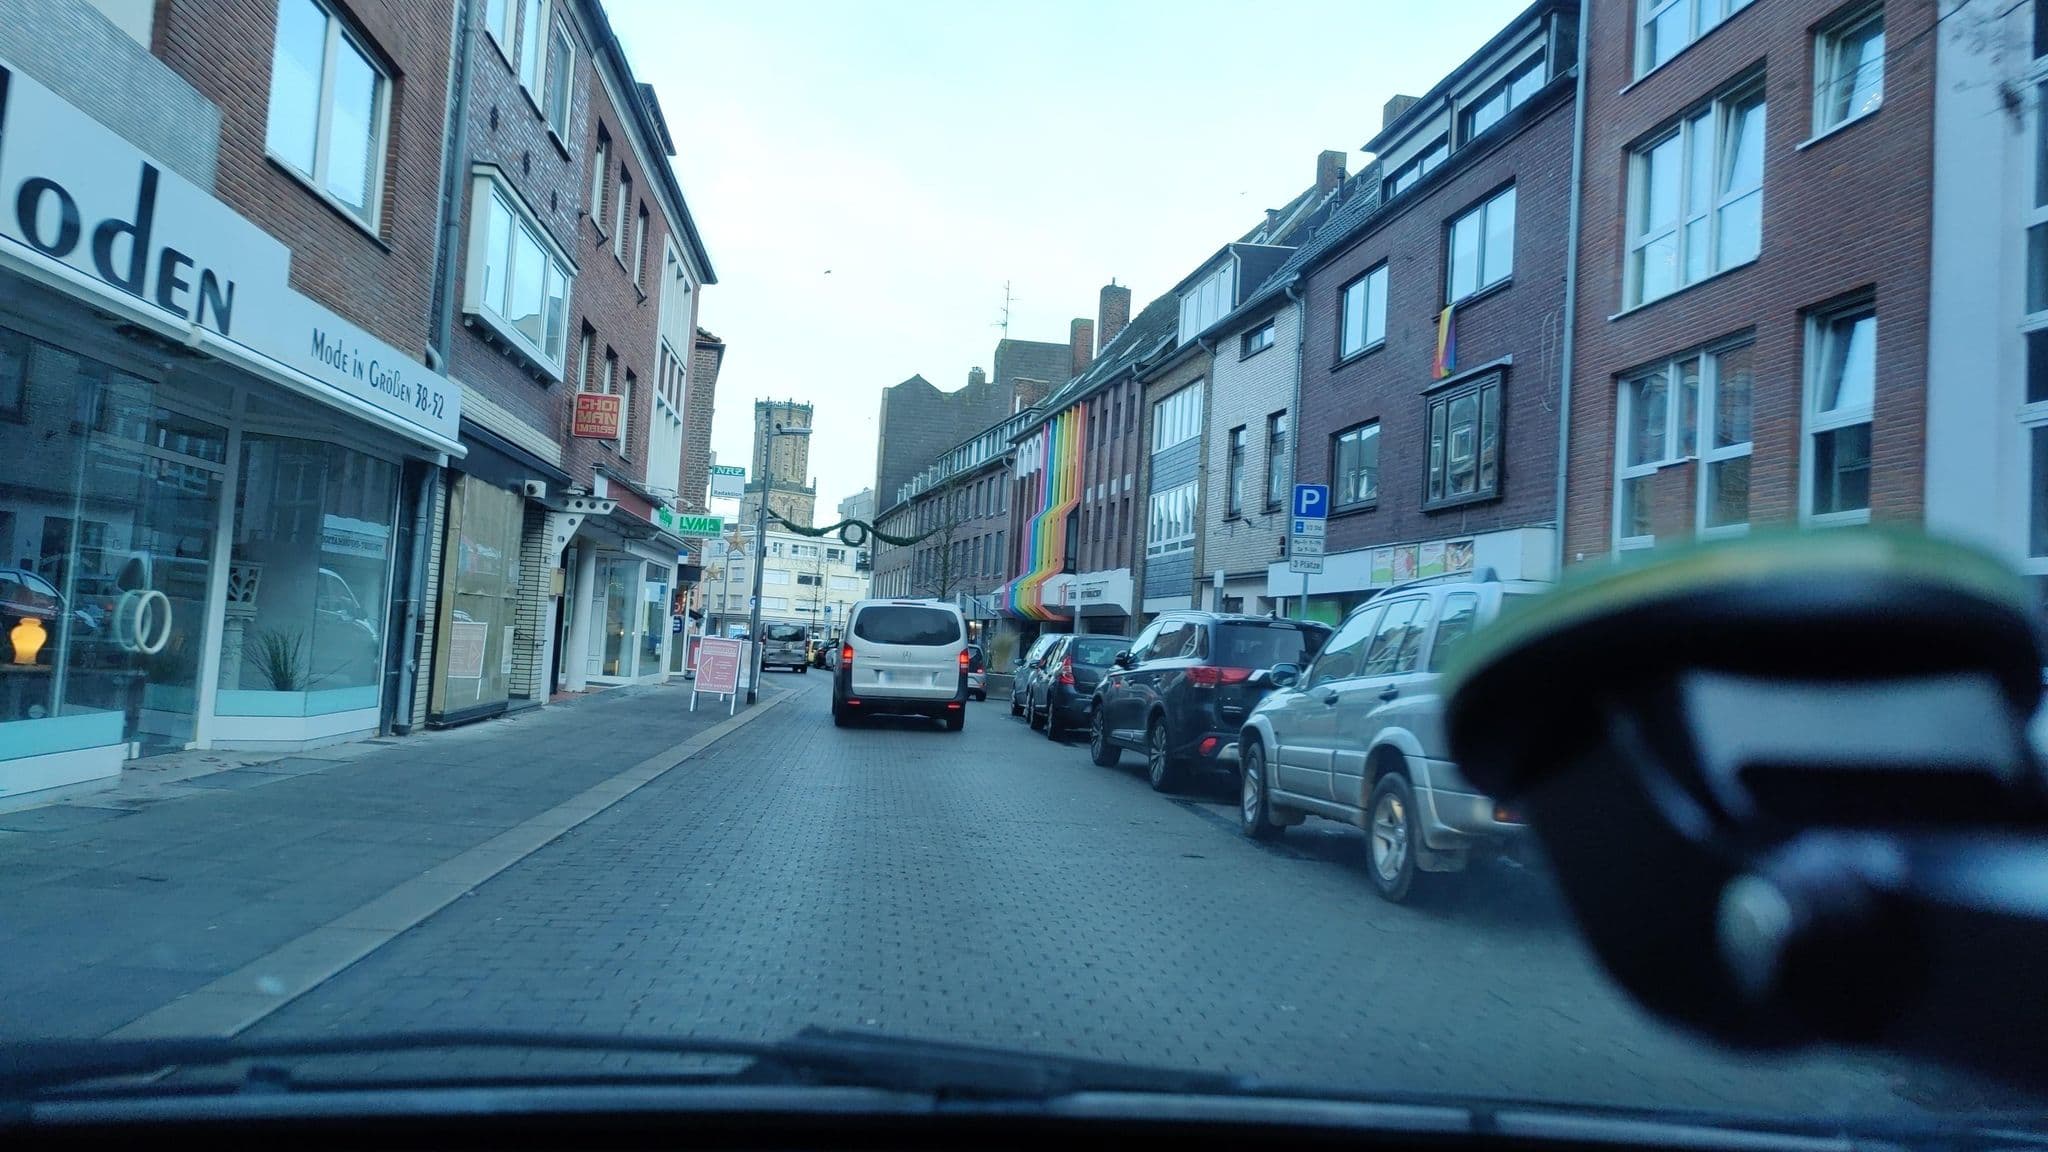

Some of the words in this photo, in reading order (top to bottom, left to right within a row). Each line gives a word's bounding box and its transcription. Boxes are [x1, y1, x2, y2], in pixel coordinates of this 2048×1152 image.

[577, 398, 618, 411] CHOI
[576, 410, 617, 425] MAN
[575, 423, 616, 434] IMBISS
[716, 467, 743, 476] NRZ
[713, 489, 742, 497] Redaktion
[1301, 489, 1320, 514] P
[680, 516, 708, 531] LVM
